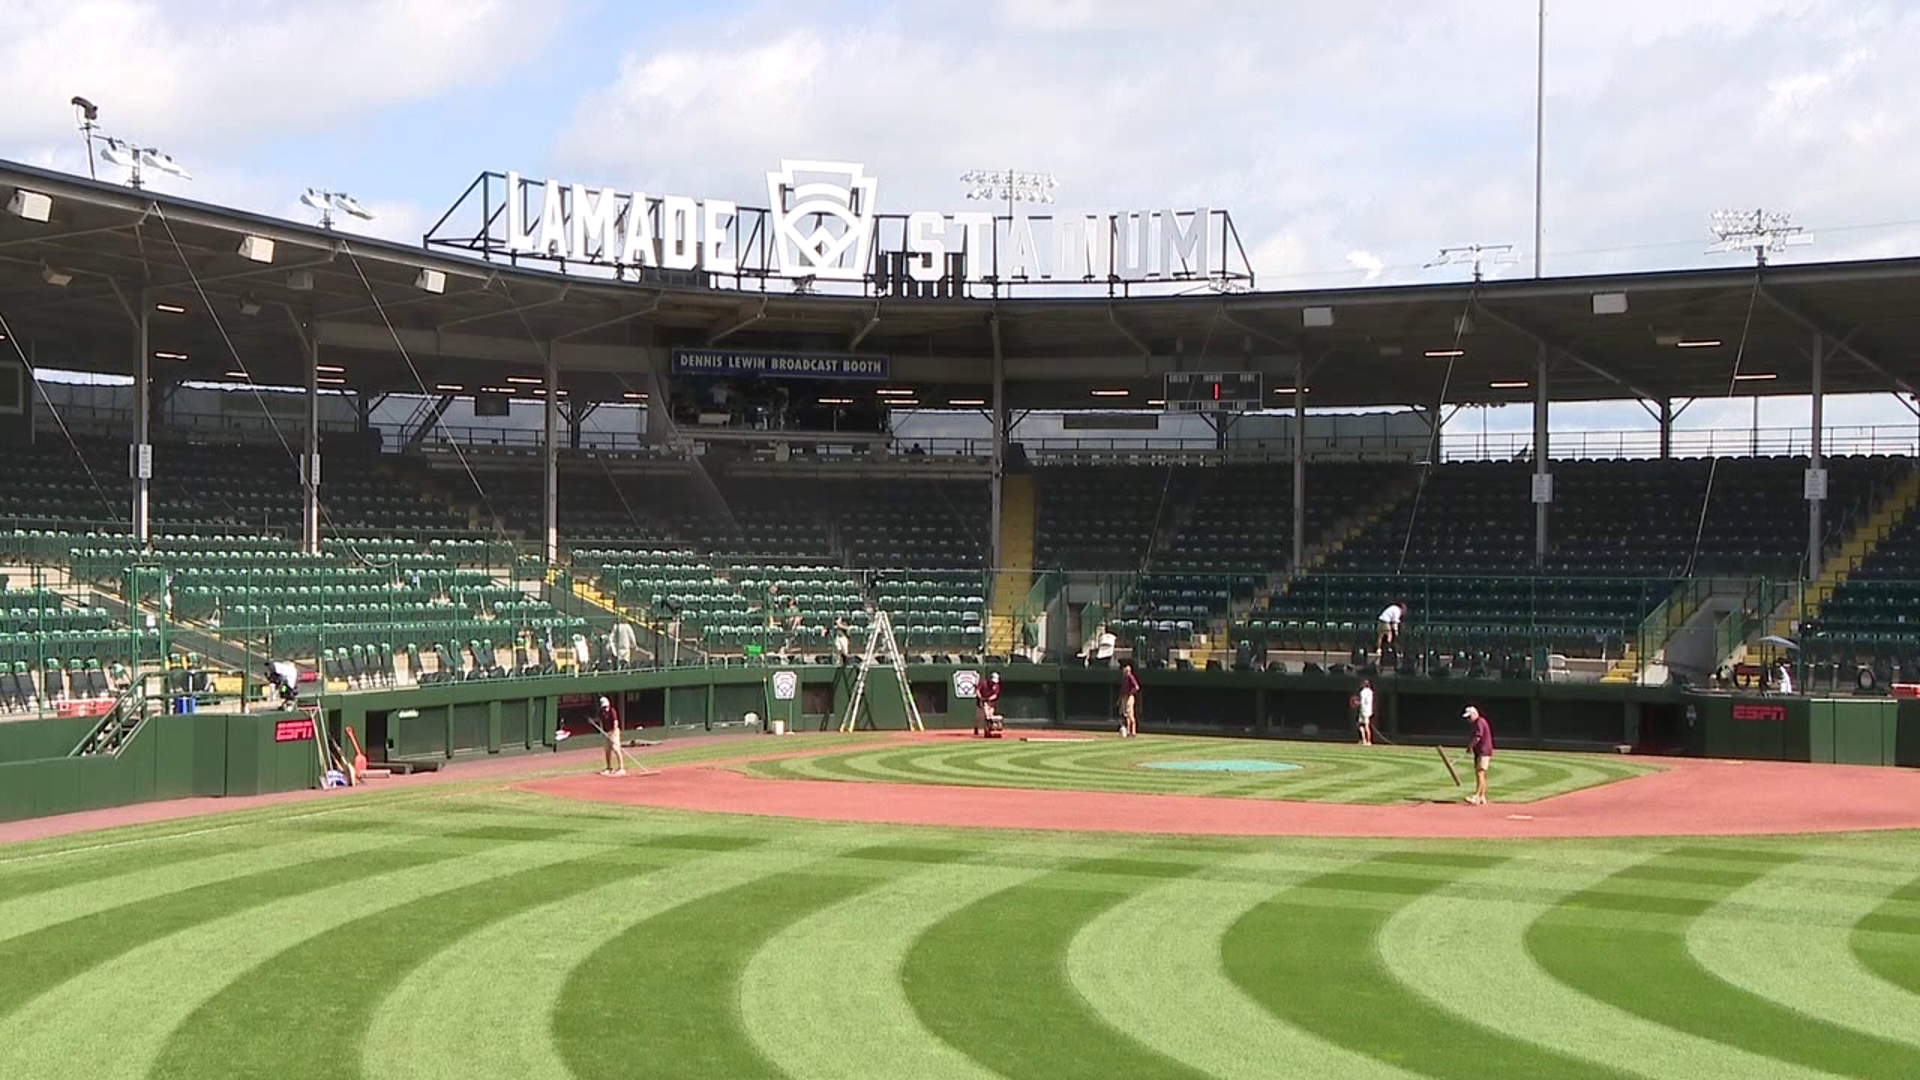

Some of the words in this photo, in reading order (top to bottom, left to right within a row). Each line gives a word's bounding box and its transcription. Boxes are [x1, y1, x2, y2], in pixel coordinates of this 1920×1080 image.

[506, 171, 738, 272] LAMADE
[906, 206, 1211, 283] STADIUM
[680, 354, 723, 368] DENNIS
[729, 356, 766, 370] LEWIN
[771, 358, 838, 372] BROADCAST
[843, 360, 882, 374] BOOTH
[1733, 705, 1785, 720] ESPN
[276, 721, 313, 741] ESPN
